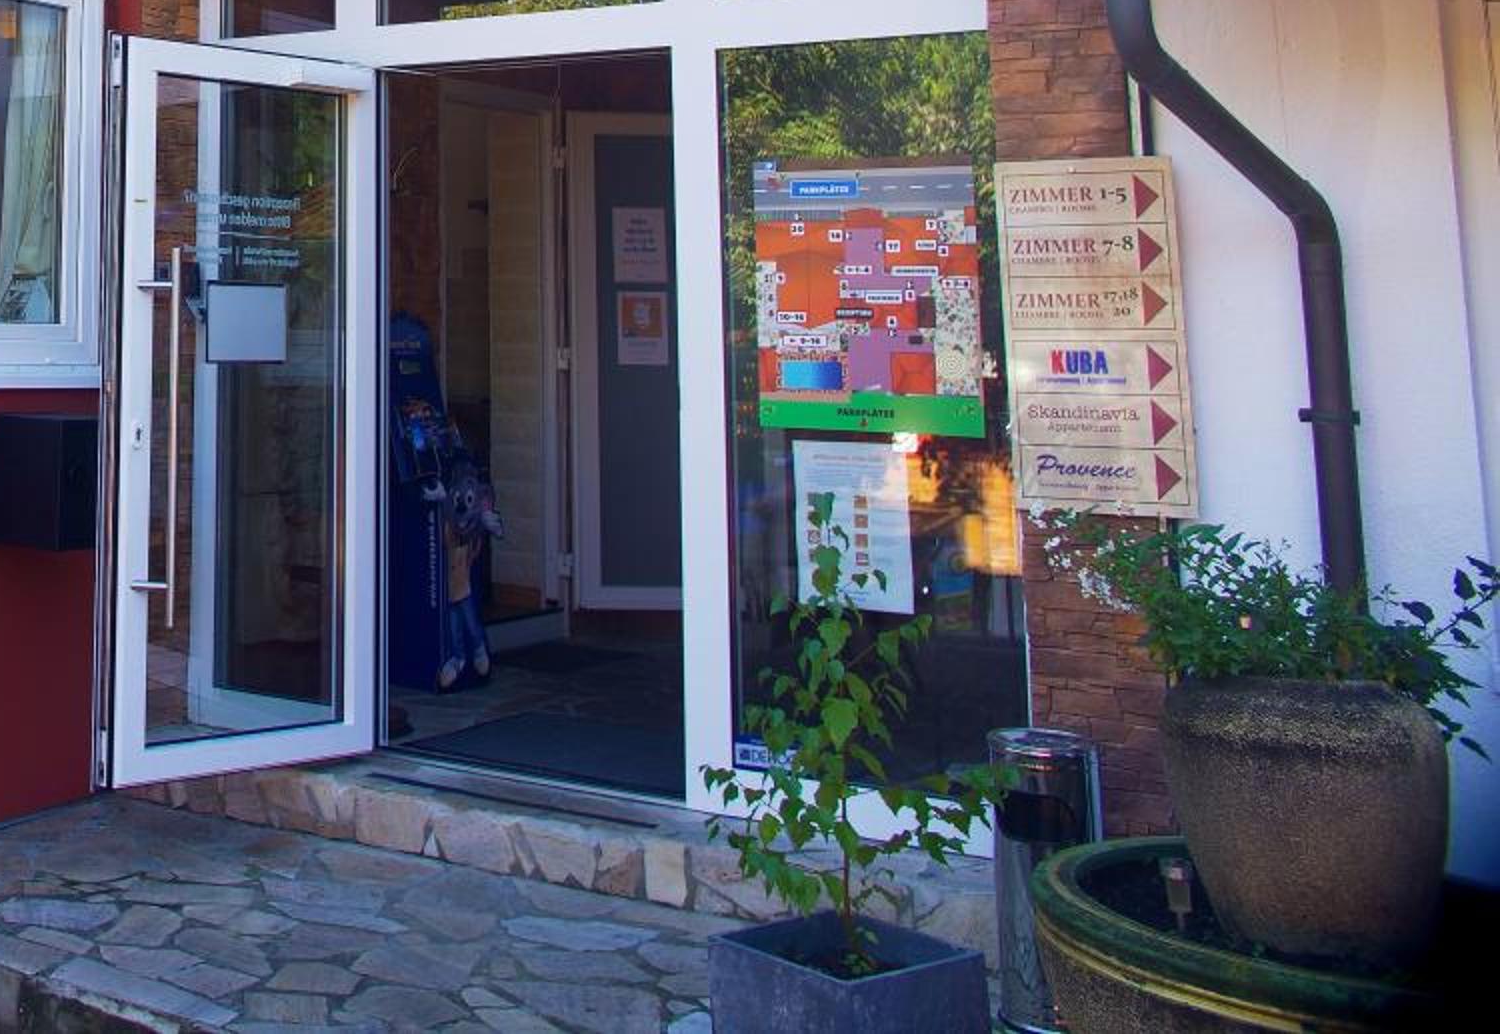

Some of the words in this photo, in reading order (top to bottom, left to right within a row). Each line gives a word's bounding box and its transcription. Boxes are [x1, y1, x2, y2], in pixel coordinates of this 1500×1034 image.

[1009, 187, 1093, 203] ZIMMER
[1100, 187, 1127, 205] 1-5
[1013, 239, 1096, 255] ZIMMER
[1102, 235, 1134, 255] 7-8
[1016, 293, 1100, 307] ZIMMER
[1051, 350, 1109, 374] KUBA
[1028, 405, 1140, 421] Skandinavia
[1037, 453, 1135, 478] Provence
